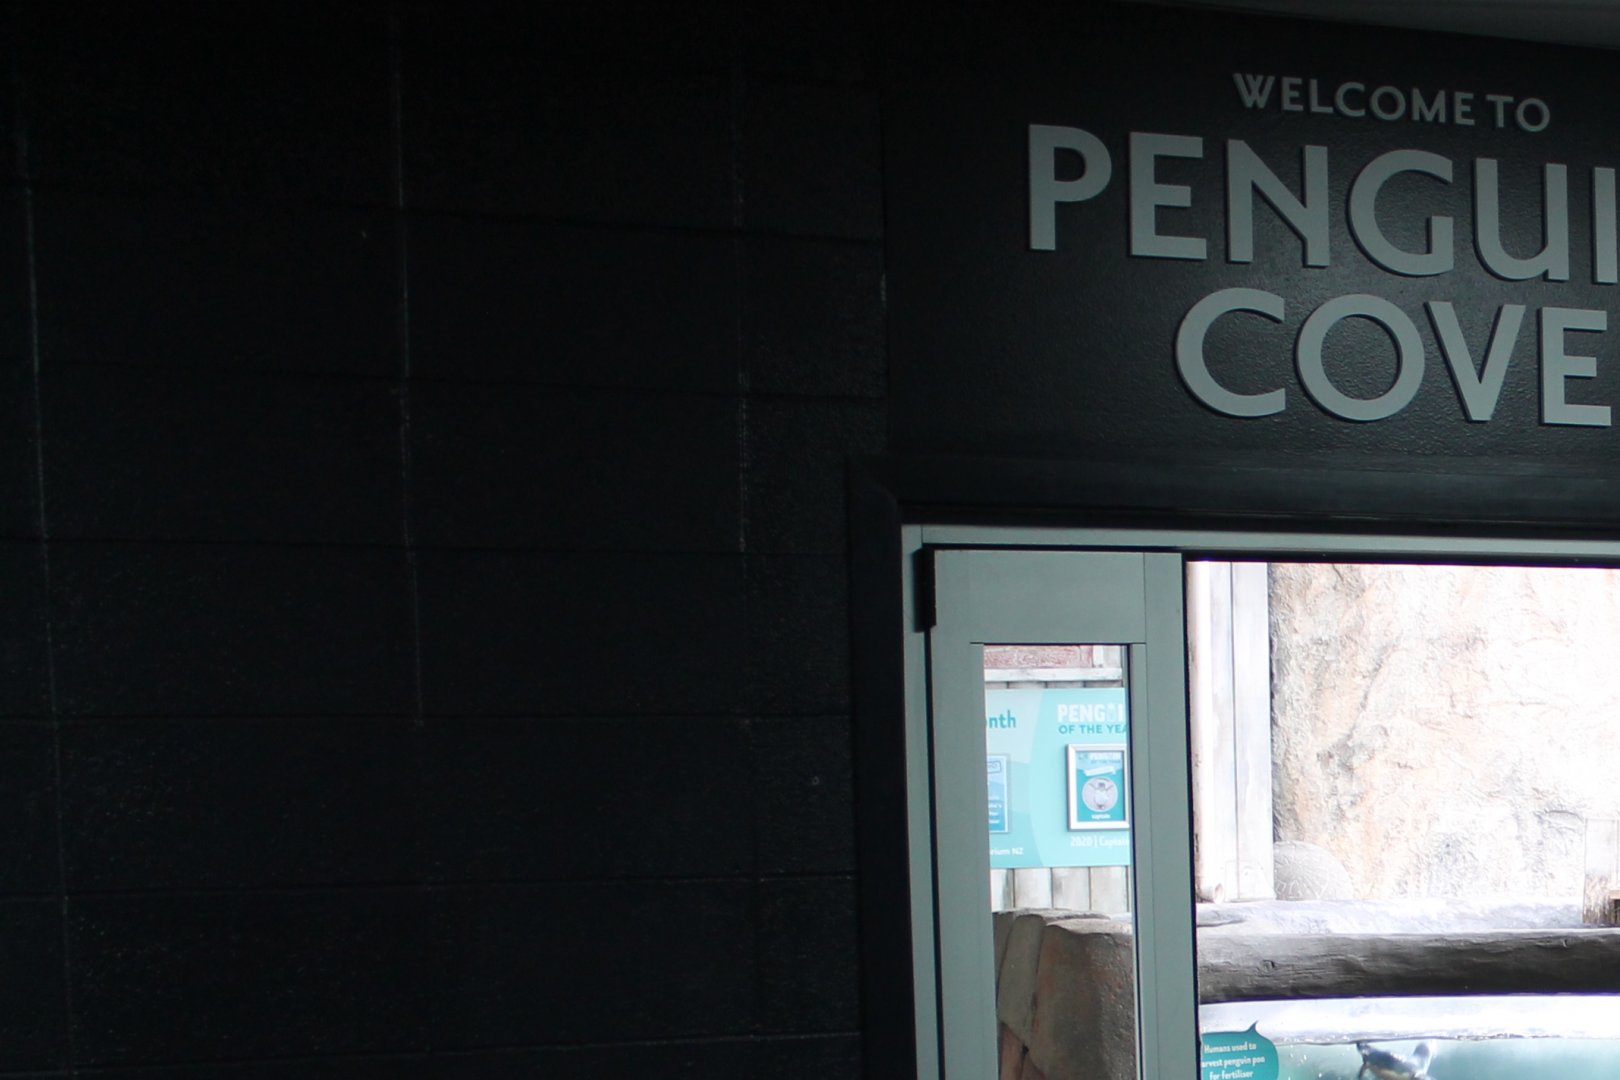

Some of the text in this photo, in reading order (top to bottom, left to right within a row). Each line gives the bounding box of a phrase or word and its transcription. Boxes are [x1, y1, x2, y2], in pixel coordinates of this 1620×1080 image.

[1232, 73, 1552, 132] WELCOME TO
[1174, 287, 1613, 427] COVE
[1058, 724, 1075, 735] OF
[1080, 724, 1103, 735] THE
[1204, 1044, 1231, 1053] Humans
[1224, 1056, 1251, 1068] penguin
